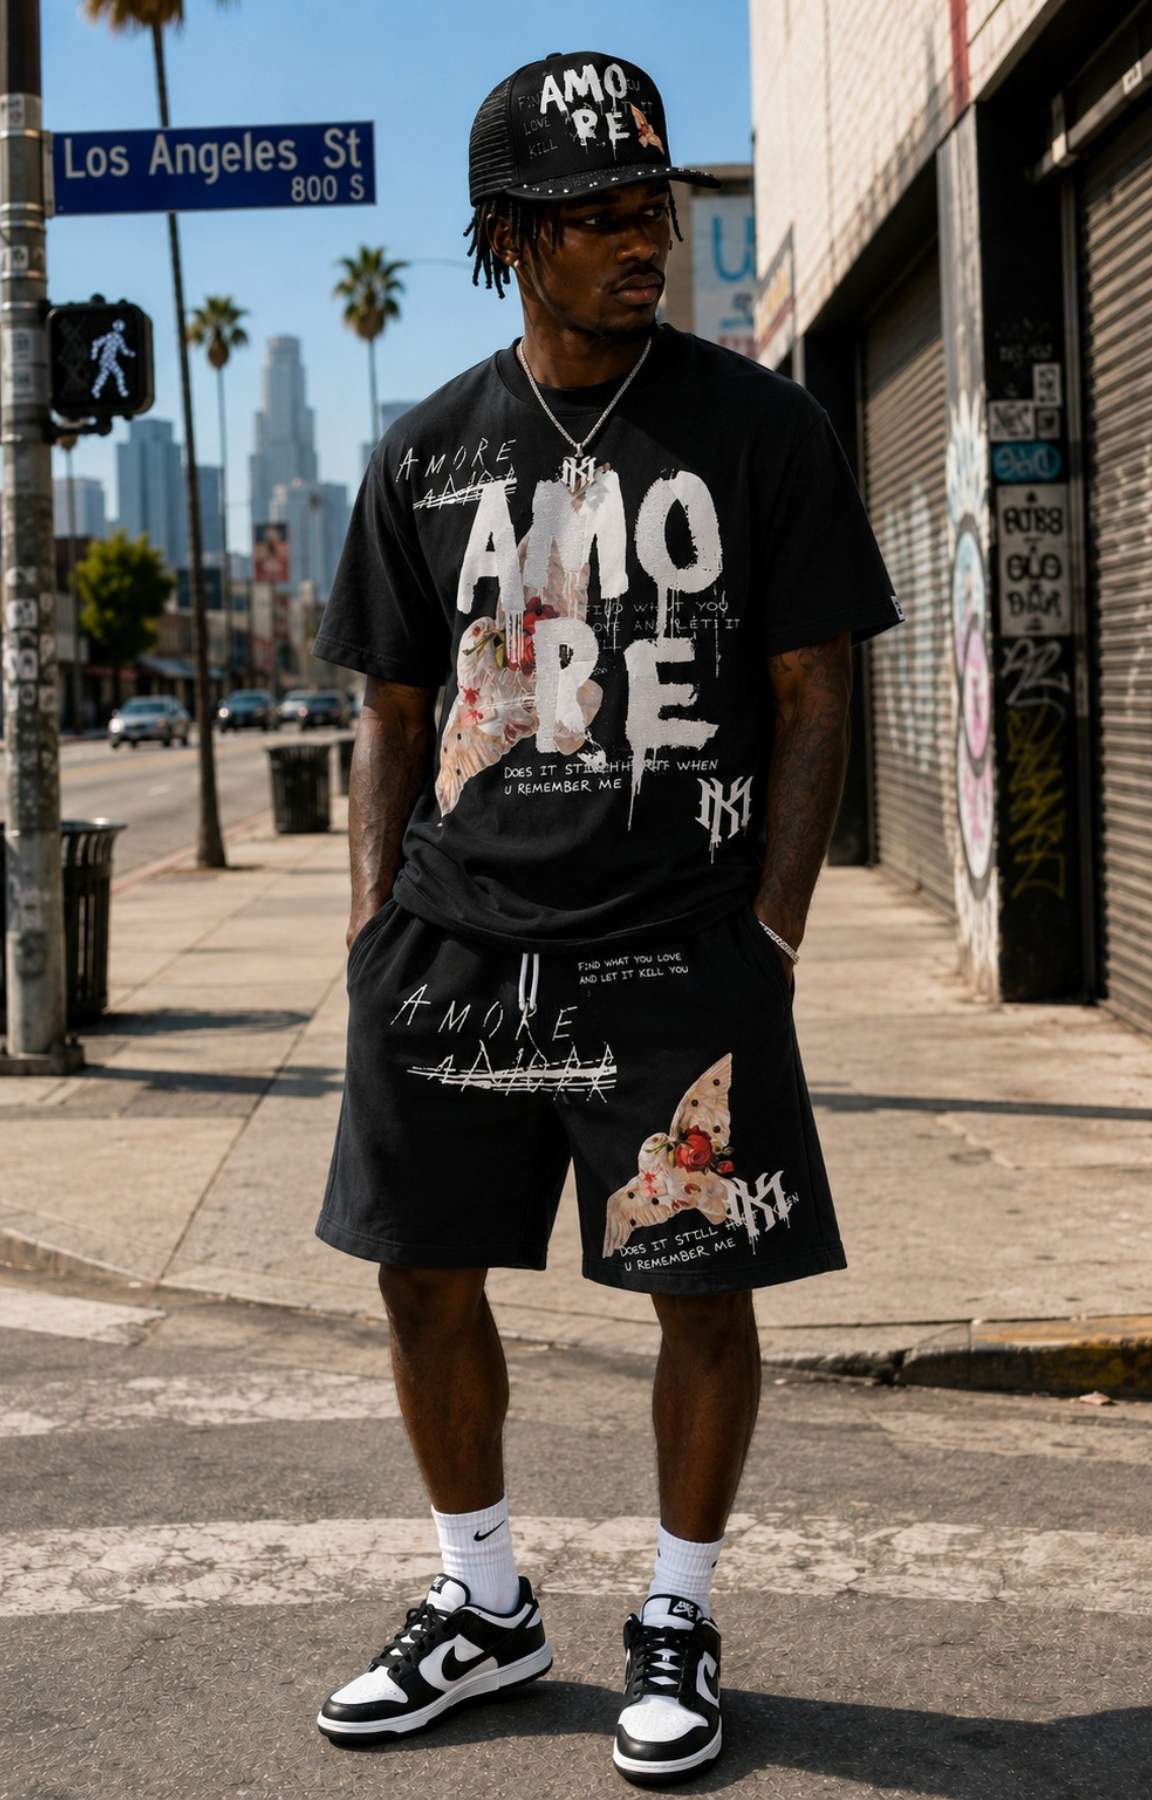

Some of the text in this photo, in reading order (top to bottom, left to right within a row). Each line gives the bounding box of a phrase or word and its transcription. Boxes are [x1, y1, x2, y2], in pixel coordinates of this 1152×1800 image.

[540, 63, 628, 115] AMO
[523, 117, 552, 136] LOVE
[571, 108, 630, 146] RE
[64, 128, 362, 185] Los Angeles St
[528, 139, 559, 160] KILL
[291, 173, 365, 203] 800 S
[395, 437, 517, 483] AMORE
[457, 470, 724, 615] AMO
[633, 601, 684, 613] WHT
[696, 601, 729, 612] YOU
[592, 620, 622, 632] OVE
[633, 619, 657, 632] AN
[534, 617, 720, 755] RE
[504, 766, 533, 779] DOES
[539, 764, 554, 777] IT
[676, 759, 719, 772] WHEN
[504, 777, 622, 796] U REMEMBER ME
[577, 952, 682, 972] FIND WHAT YOU LOVE
[579, 965, 689, 985] AND LET IT KILL YOU
[389, 984, 579, 1041] AMORE
[619, 1243, 646, 1257] DOES
[651, 1238, 668, 1252] IT
[675, 1226, 719, 1245] STILL
[624, 1237, 737, 1272] U REMEMBER ME
